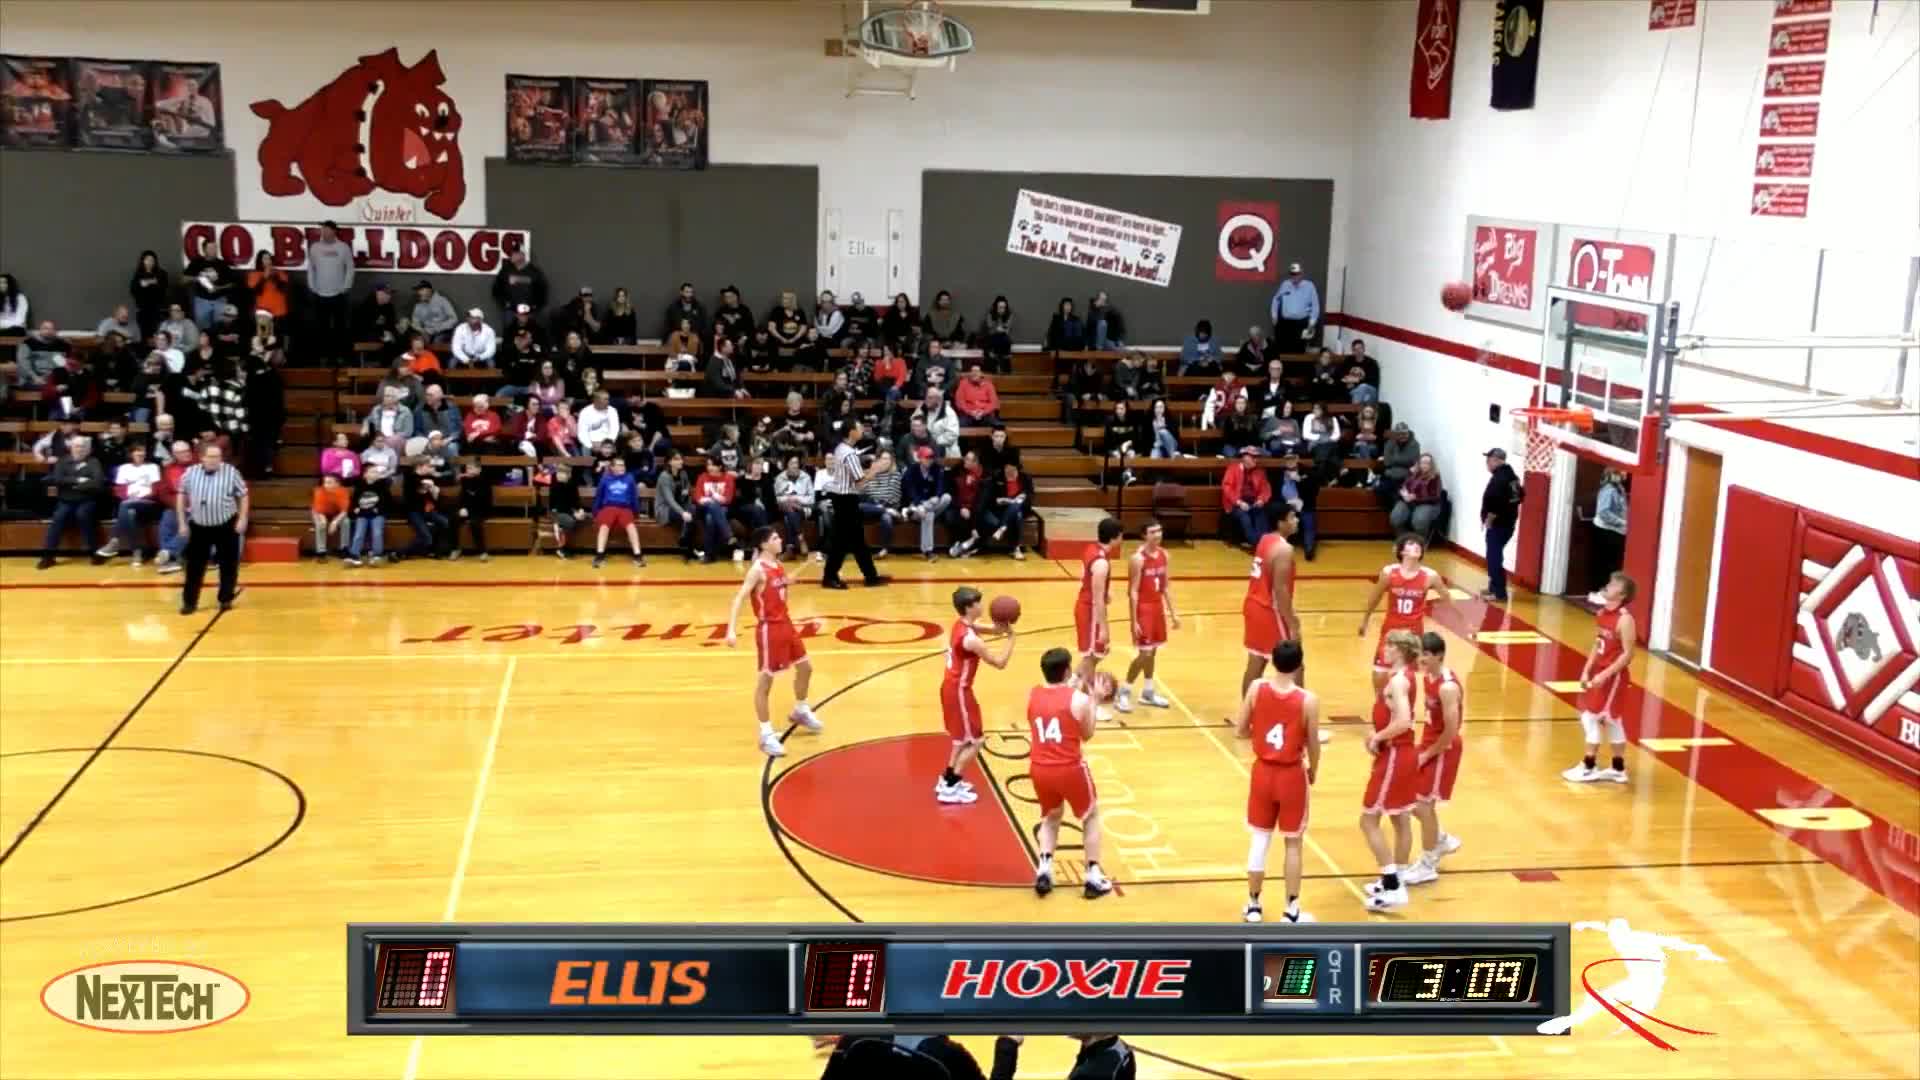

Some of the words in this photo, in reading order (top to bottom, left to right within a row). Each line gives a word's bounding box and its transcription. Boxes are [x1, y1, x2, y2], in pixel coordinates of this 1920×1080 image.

[362, 198, 412, 222] Quinter
[184, 223, 254, 267] GO
[271, 225, 524, 272] BLDOGS
[1219, 213, 1273, 273] Q
[1071, 246, 1095, 266] Crew
[1120, 258, 1132, 275] be
[1397, 597, 1414, 615] 10
[1034, 716, 1063, 744] 14
[1264, 722, 1285, 750] 4
